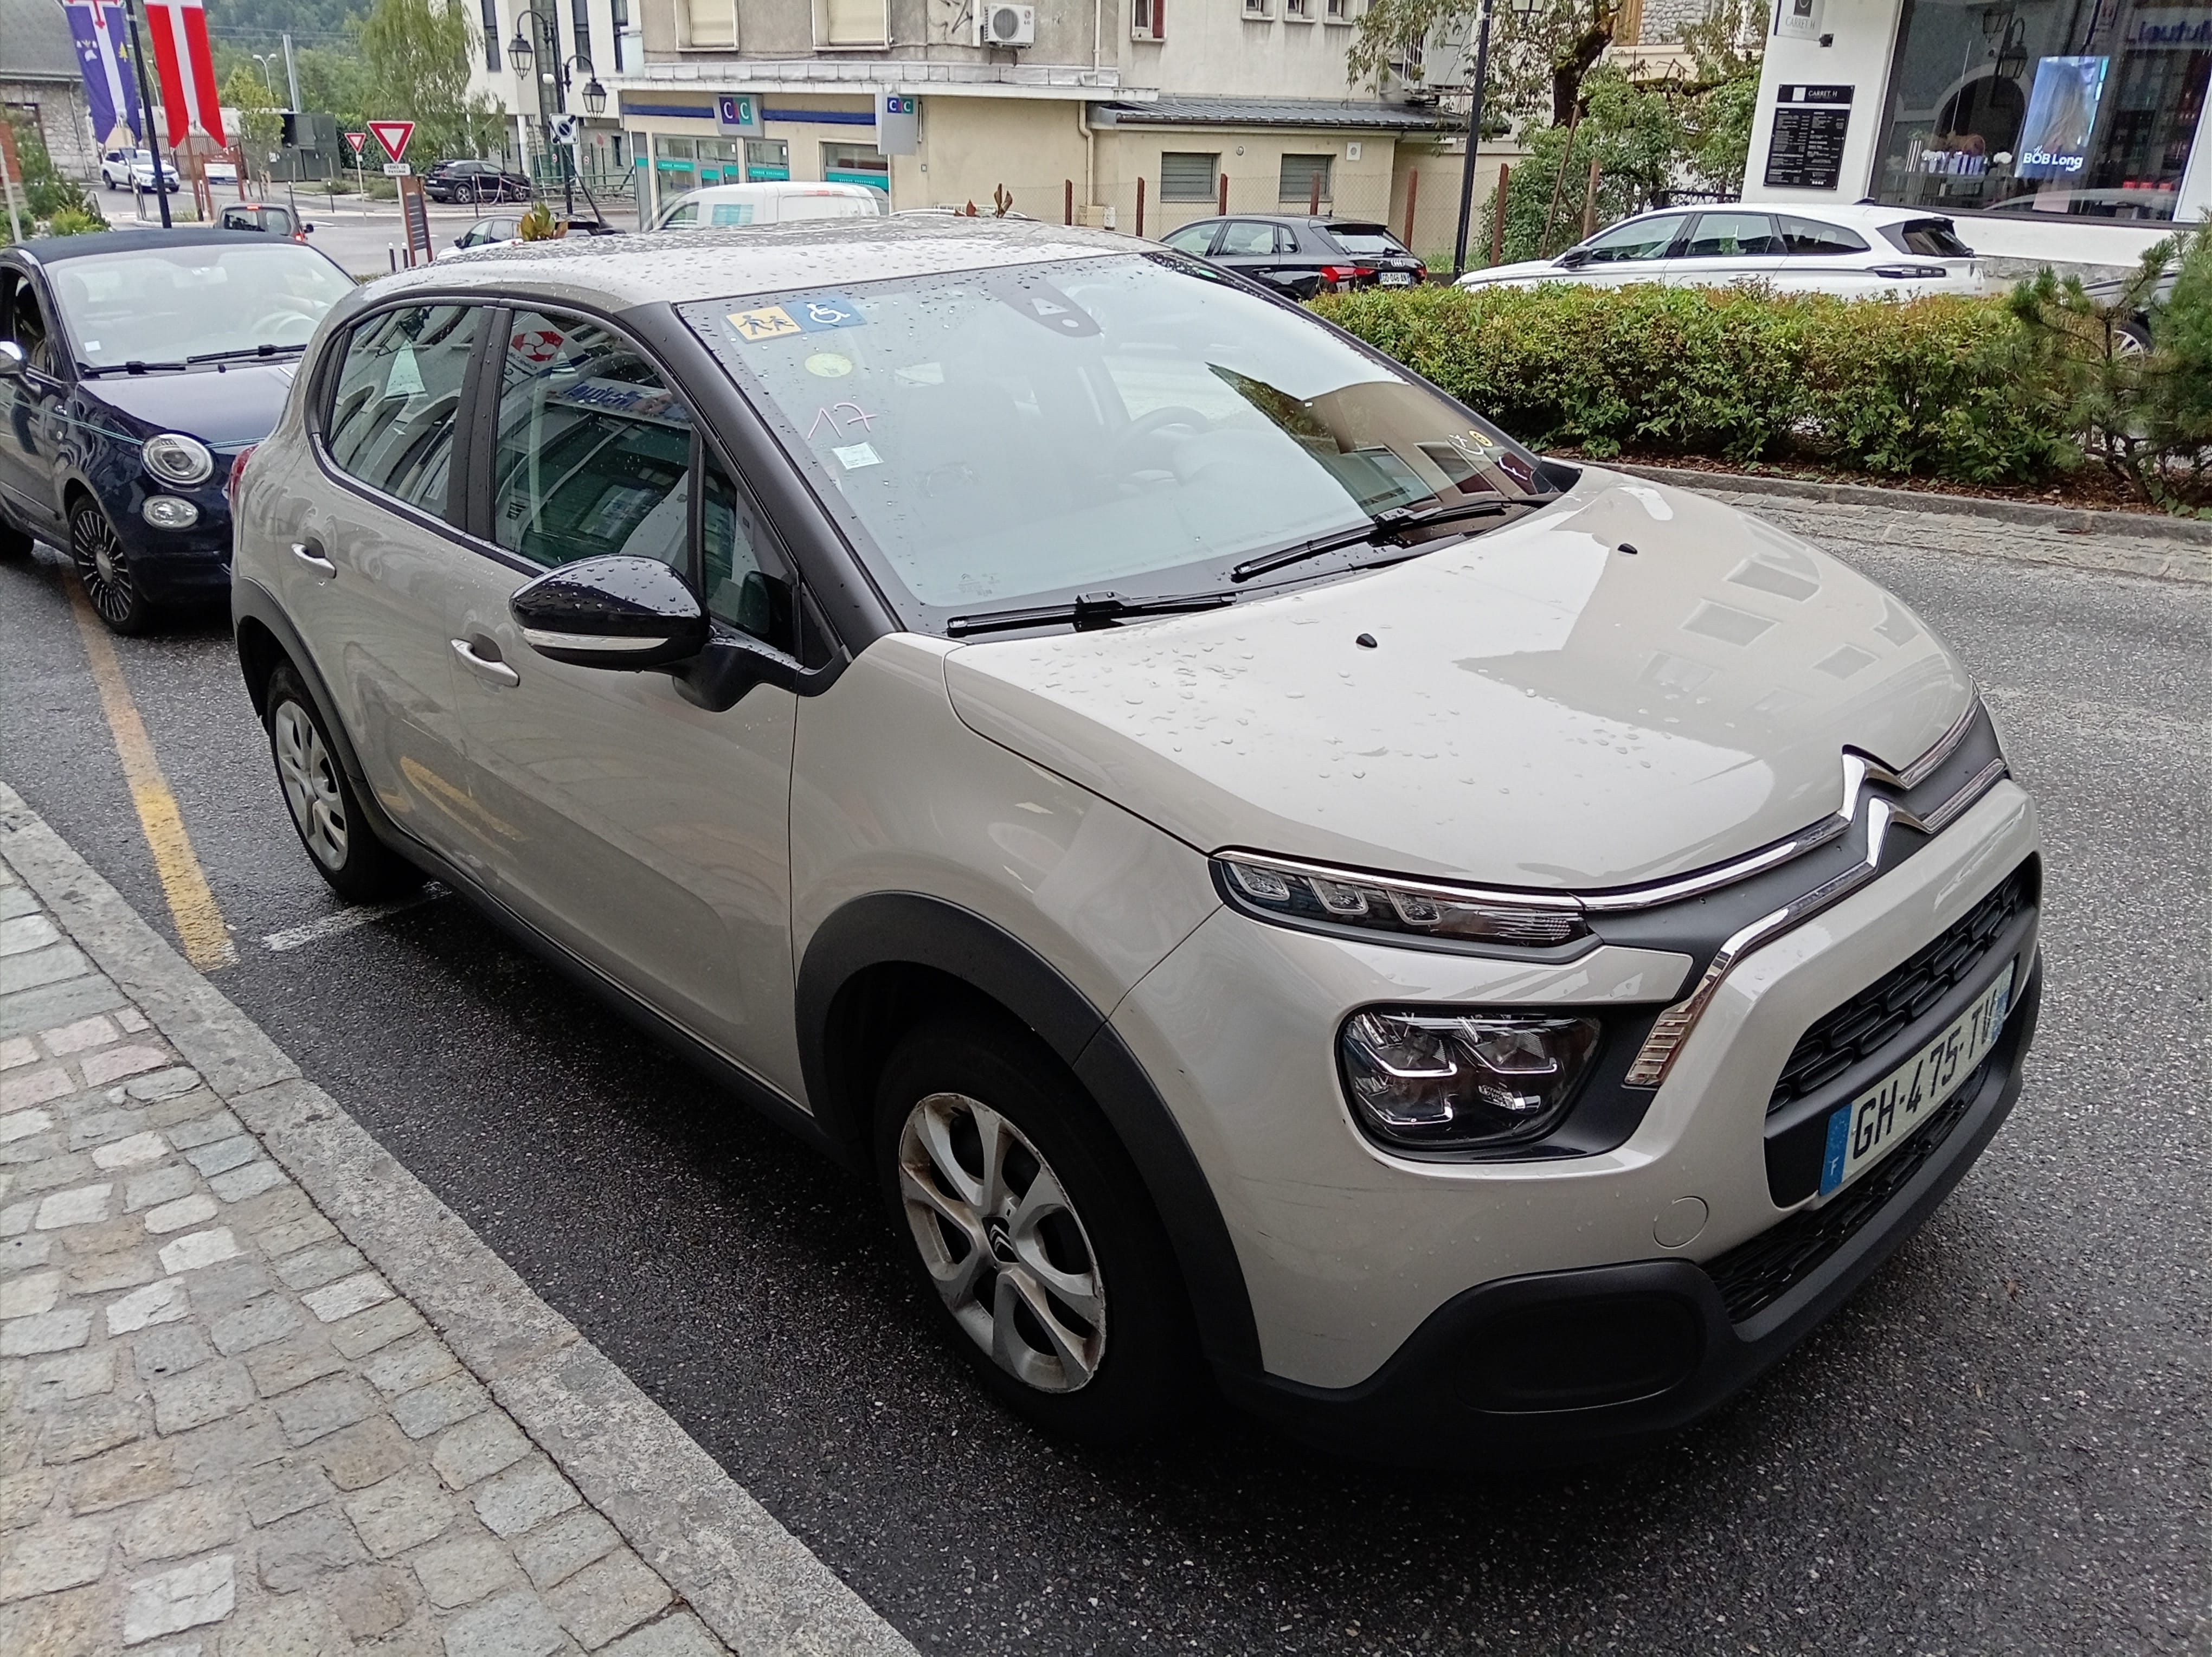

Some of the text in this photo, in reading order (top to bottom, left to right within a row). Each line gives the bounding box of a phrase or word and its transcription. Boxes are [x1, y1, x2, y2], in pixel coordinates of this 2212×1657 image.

[2023, 152, 2050, 165] BOB
[2052, 153, 2084, 170] Long
[808, 402, 877, 440] 17
